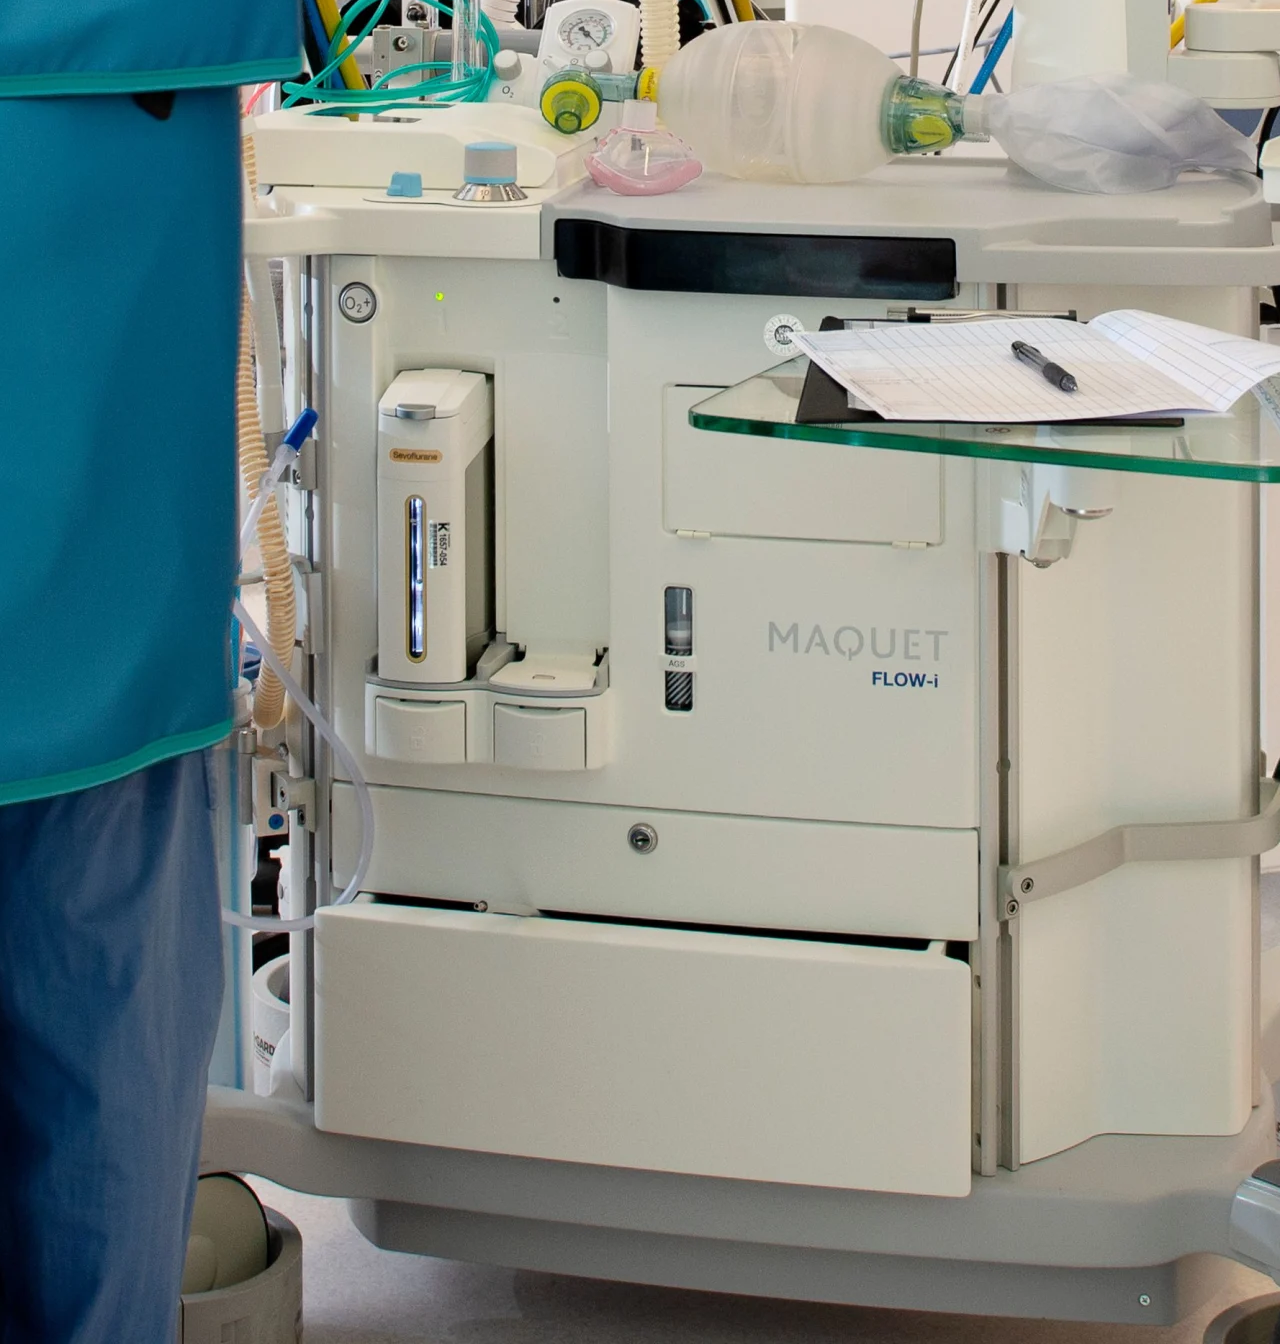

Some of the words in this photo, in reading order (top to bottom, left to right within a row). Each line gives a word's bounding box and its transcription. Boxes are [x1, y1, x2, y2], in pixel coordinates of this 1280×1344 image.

[392, 450, 438, 461] Sevoflurane
[438, 522, 449, 532] K
[439, 533, 448, 567] 1657-054
[768, 621, 949, 662] MAQUET
[668, 659, 686, 668] AGS
[872, 671, 938, 688] FLOW-i
